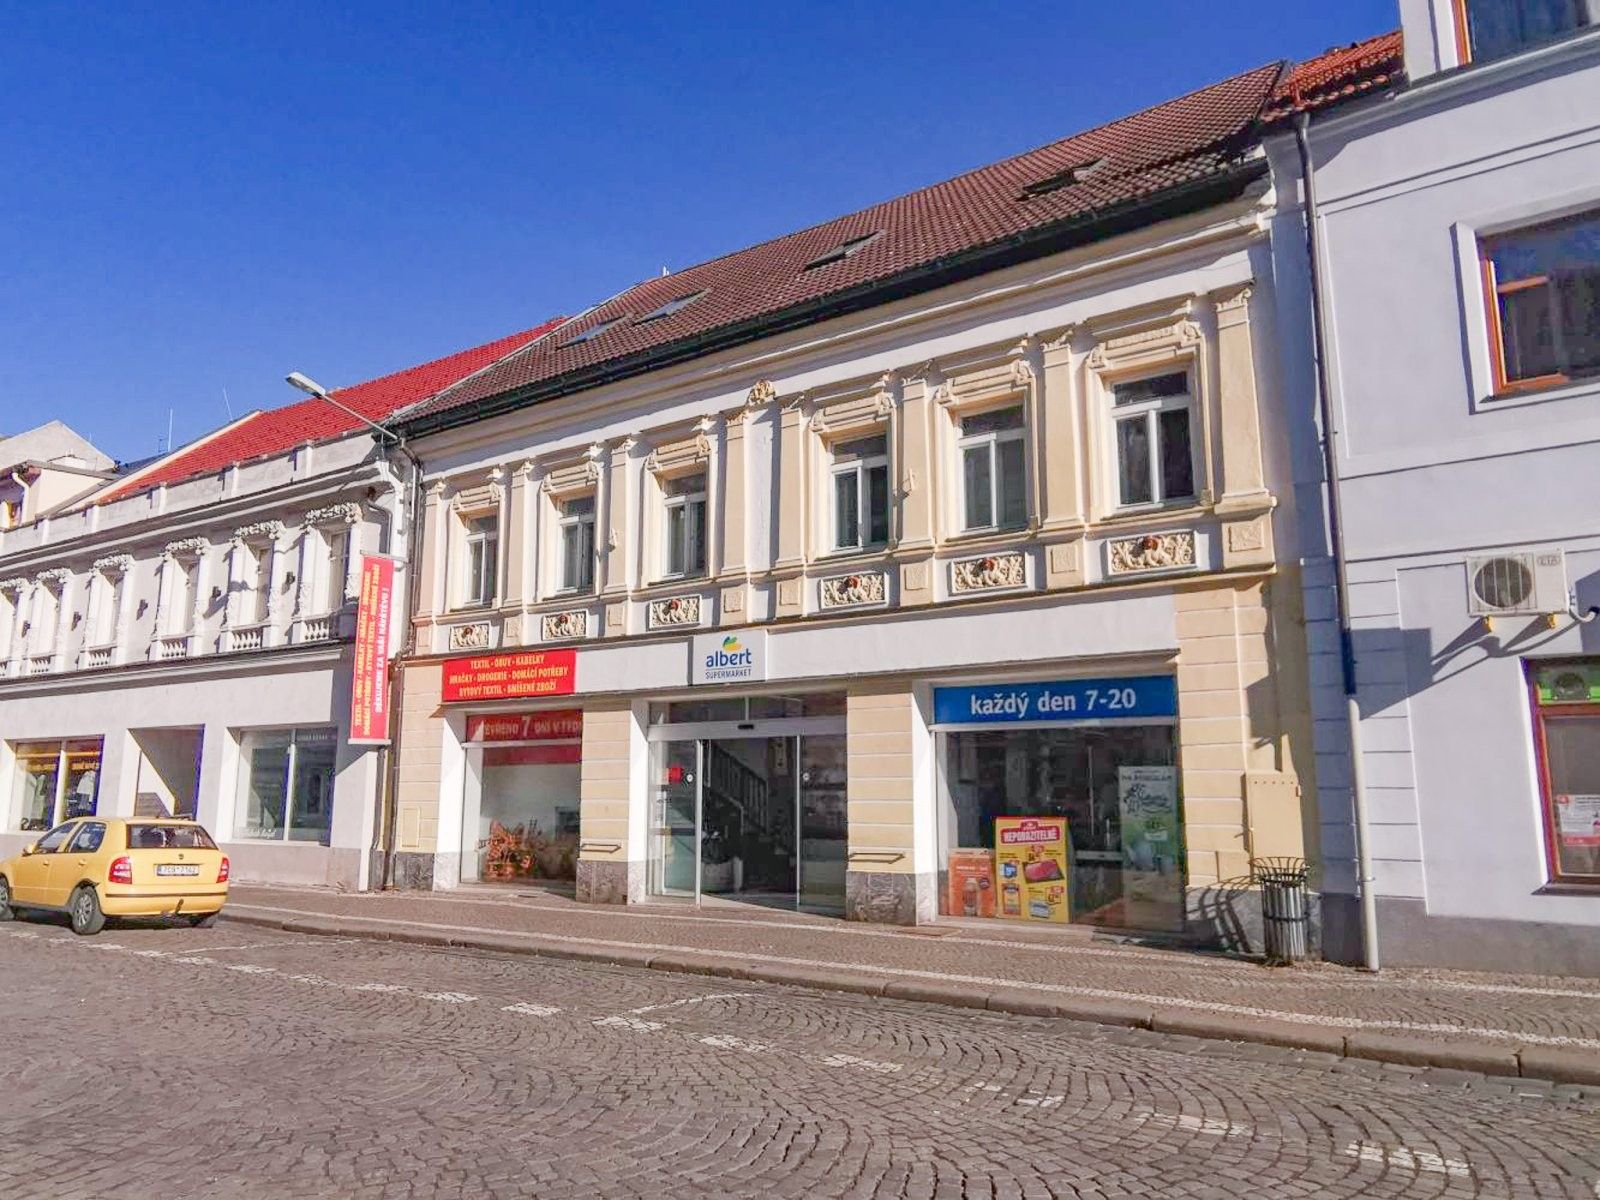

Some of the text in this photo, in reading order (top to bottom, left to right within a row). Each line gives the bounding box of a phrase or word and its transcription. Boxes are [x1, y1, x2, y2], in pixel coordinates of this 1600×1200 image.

[379, 593, 388, 634] NÁVŠTĚVU
[377, 636, 386, 655] VAŠI
[376, 657, 384, 668] ZA
[470, 654, 545, 669] TEXTIL OBUV KABELKY
[706, 648, 752, 668] albert
[449, 665, 569, 684] HRAČKY DROGERIE DOMÁCÍ POTŘEBY
[705, 669, 751, 680] SUPERMARKET
[374, 669, 383, 713] DĚKUJEME
[458, 686, 482, 698] BYTOVÝ
[482, 685, 502, 695] TEXTIL
[970, 688, 1137, 719] každý den 7-20
[354, 704, 362, 726] TEXTIL
